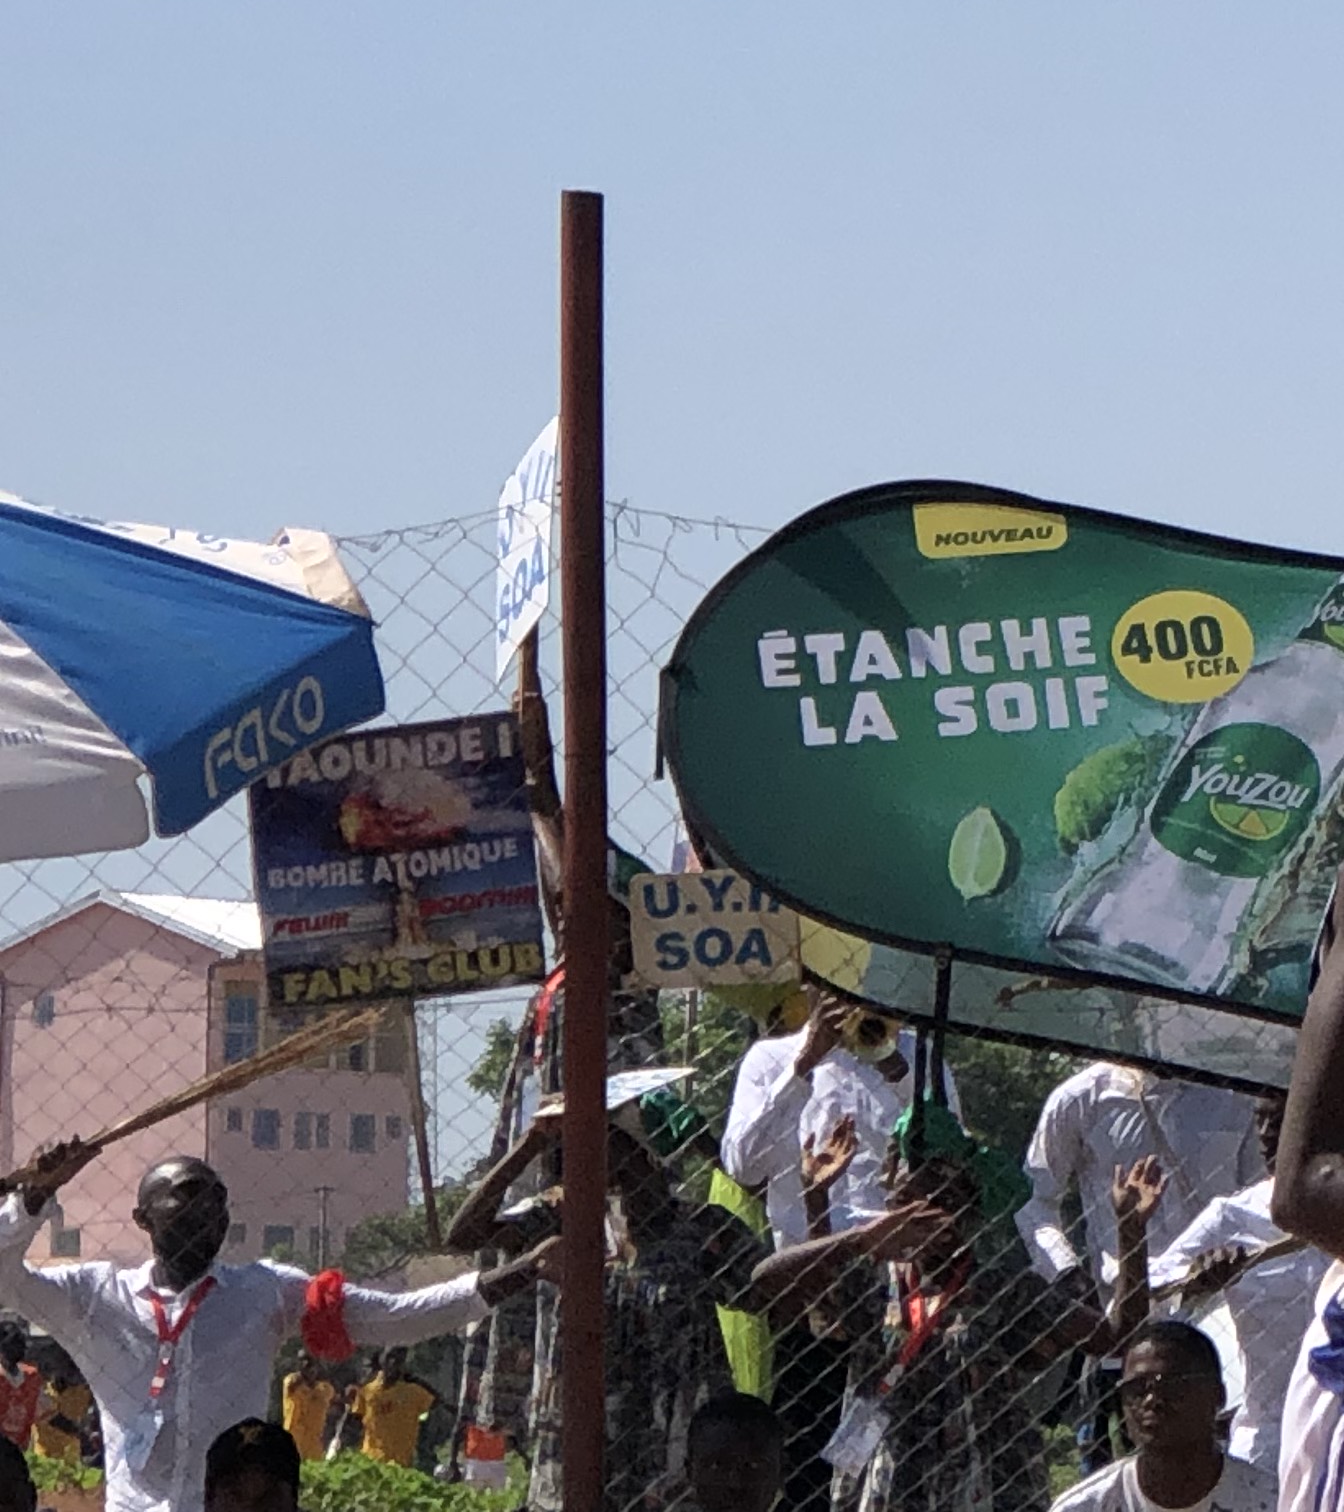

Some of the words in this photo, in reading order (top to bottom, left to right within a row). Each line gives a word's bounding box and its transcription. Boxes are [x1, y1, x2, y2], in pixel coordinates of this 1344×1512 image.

[934, 525, 1053, 547] NOUVEAU
[757, 614, 1097, 688] ÉTANCHE
[1120, 614, 1224, 664] 400
[1185, 656, 1240, 680] FCFA
[799, 690, 899, 747] LA
[933, 674, 1110, 737] SOIF
[1180, 762, 1312, 810] YouZou
[267, 858, 365, 888] BOMBE
[372, 837, 519, 884] ATOMIQUE
[282, 956, 413, 1004] FAN'S
[427, 942, 543, 983] CLUB
[655, 926, 773, 971] SOA
